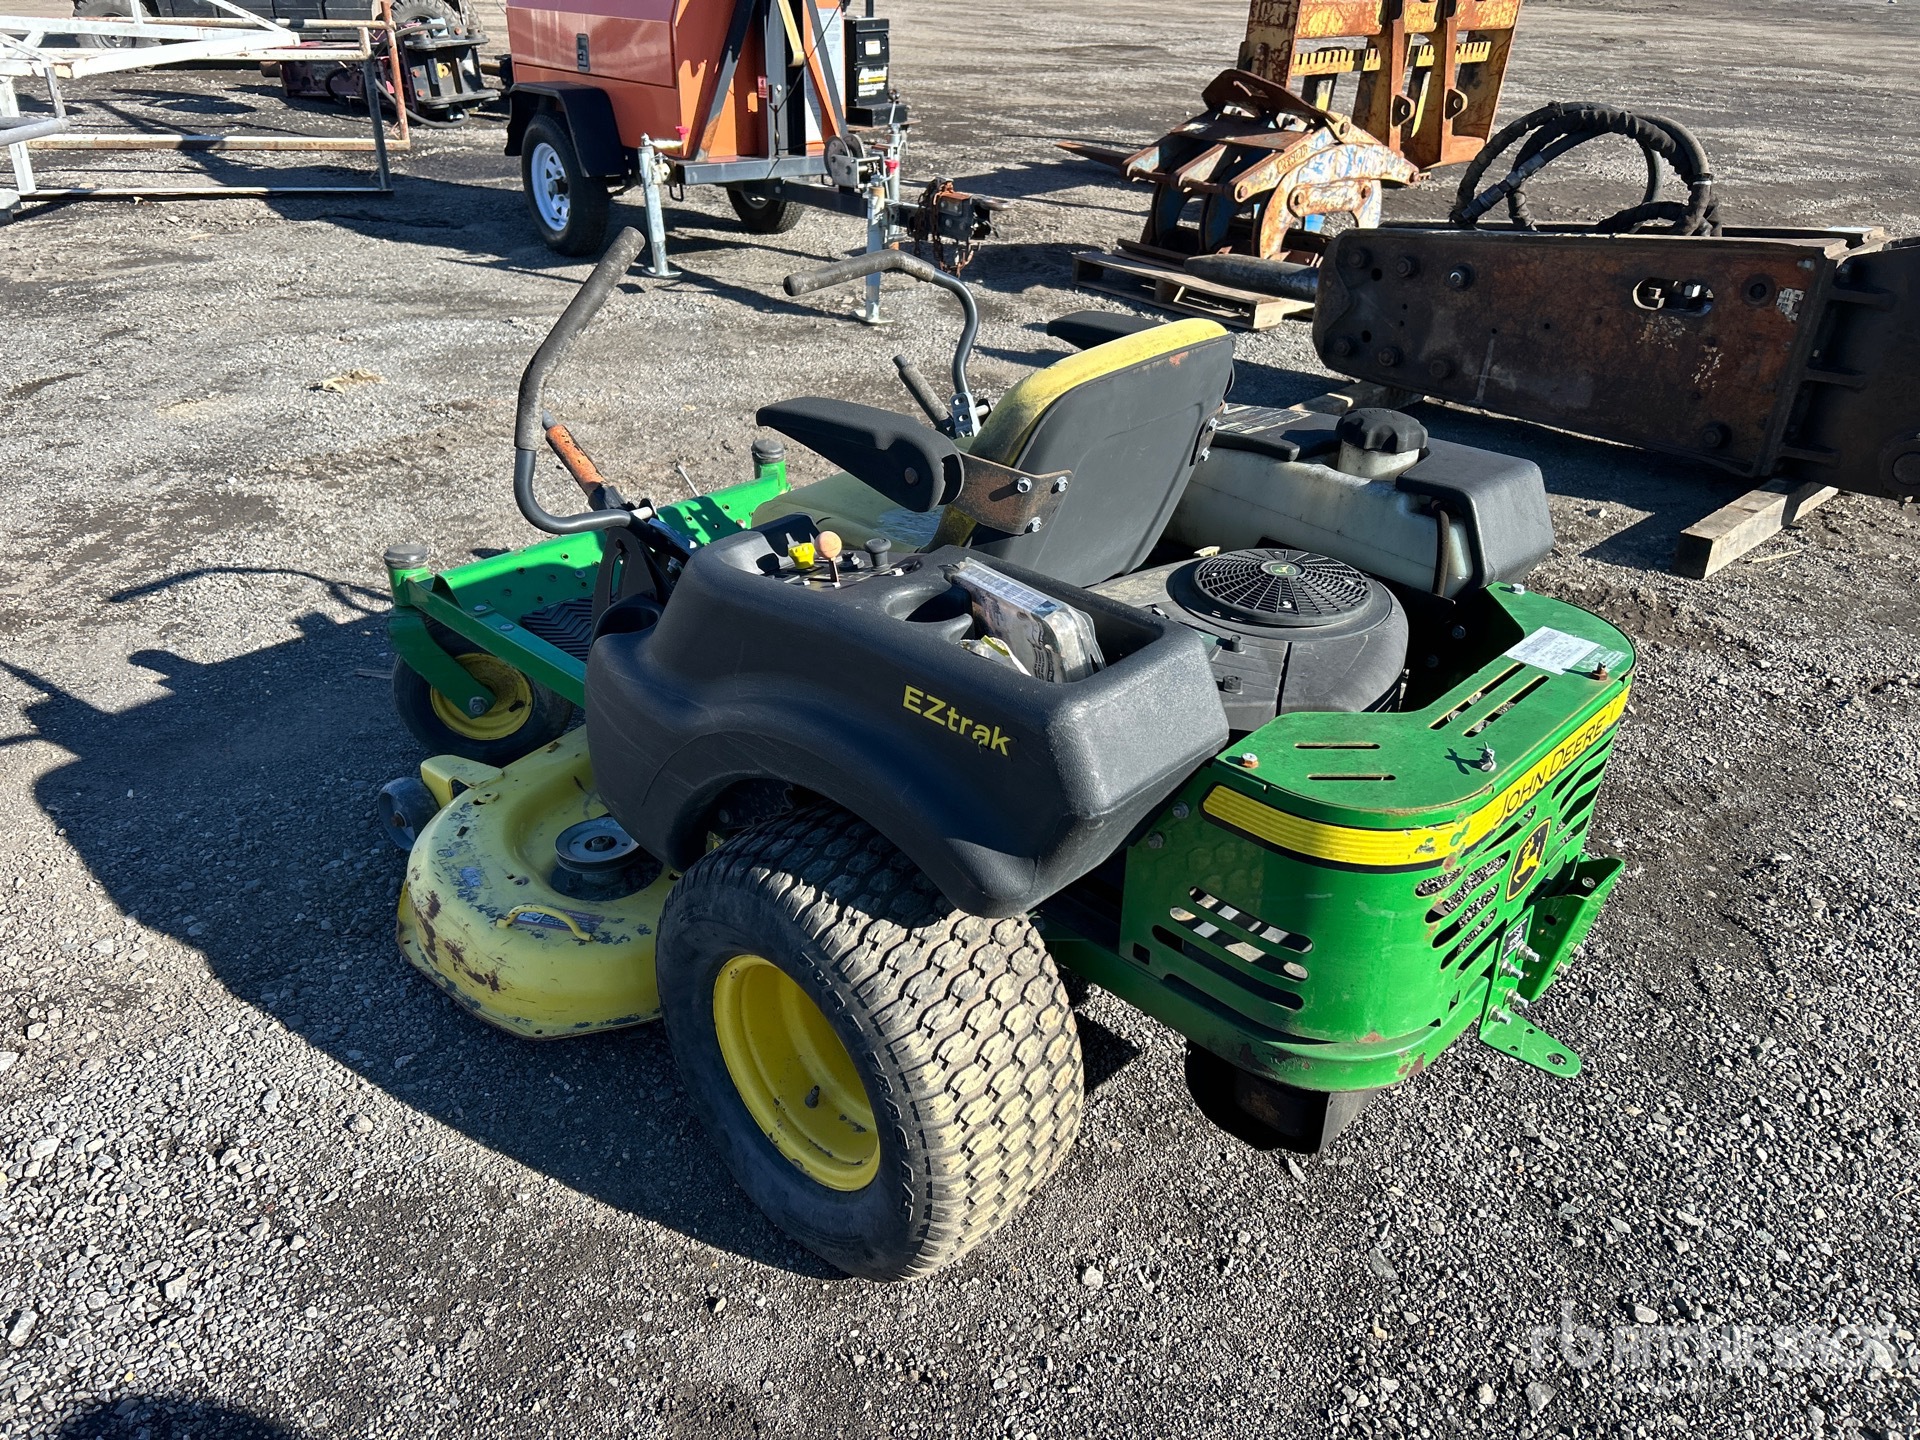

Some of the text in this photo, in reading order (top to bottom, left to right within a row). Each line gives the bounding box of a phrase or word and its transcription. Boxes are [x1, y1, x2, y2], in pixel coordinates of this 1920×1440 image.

[902, 684, 1011, 756] EZtrak
[1494, 715, 1606, 826] JOHN DEERE
[798, 951, 864, 1033] TURF
[866, 1050, 910, 1150] TRAC
